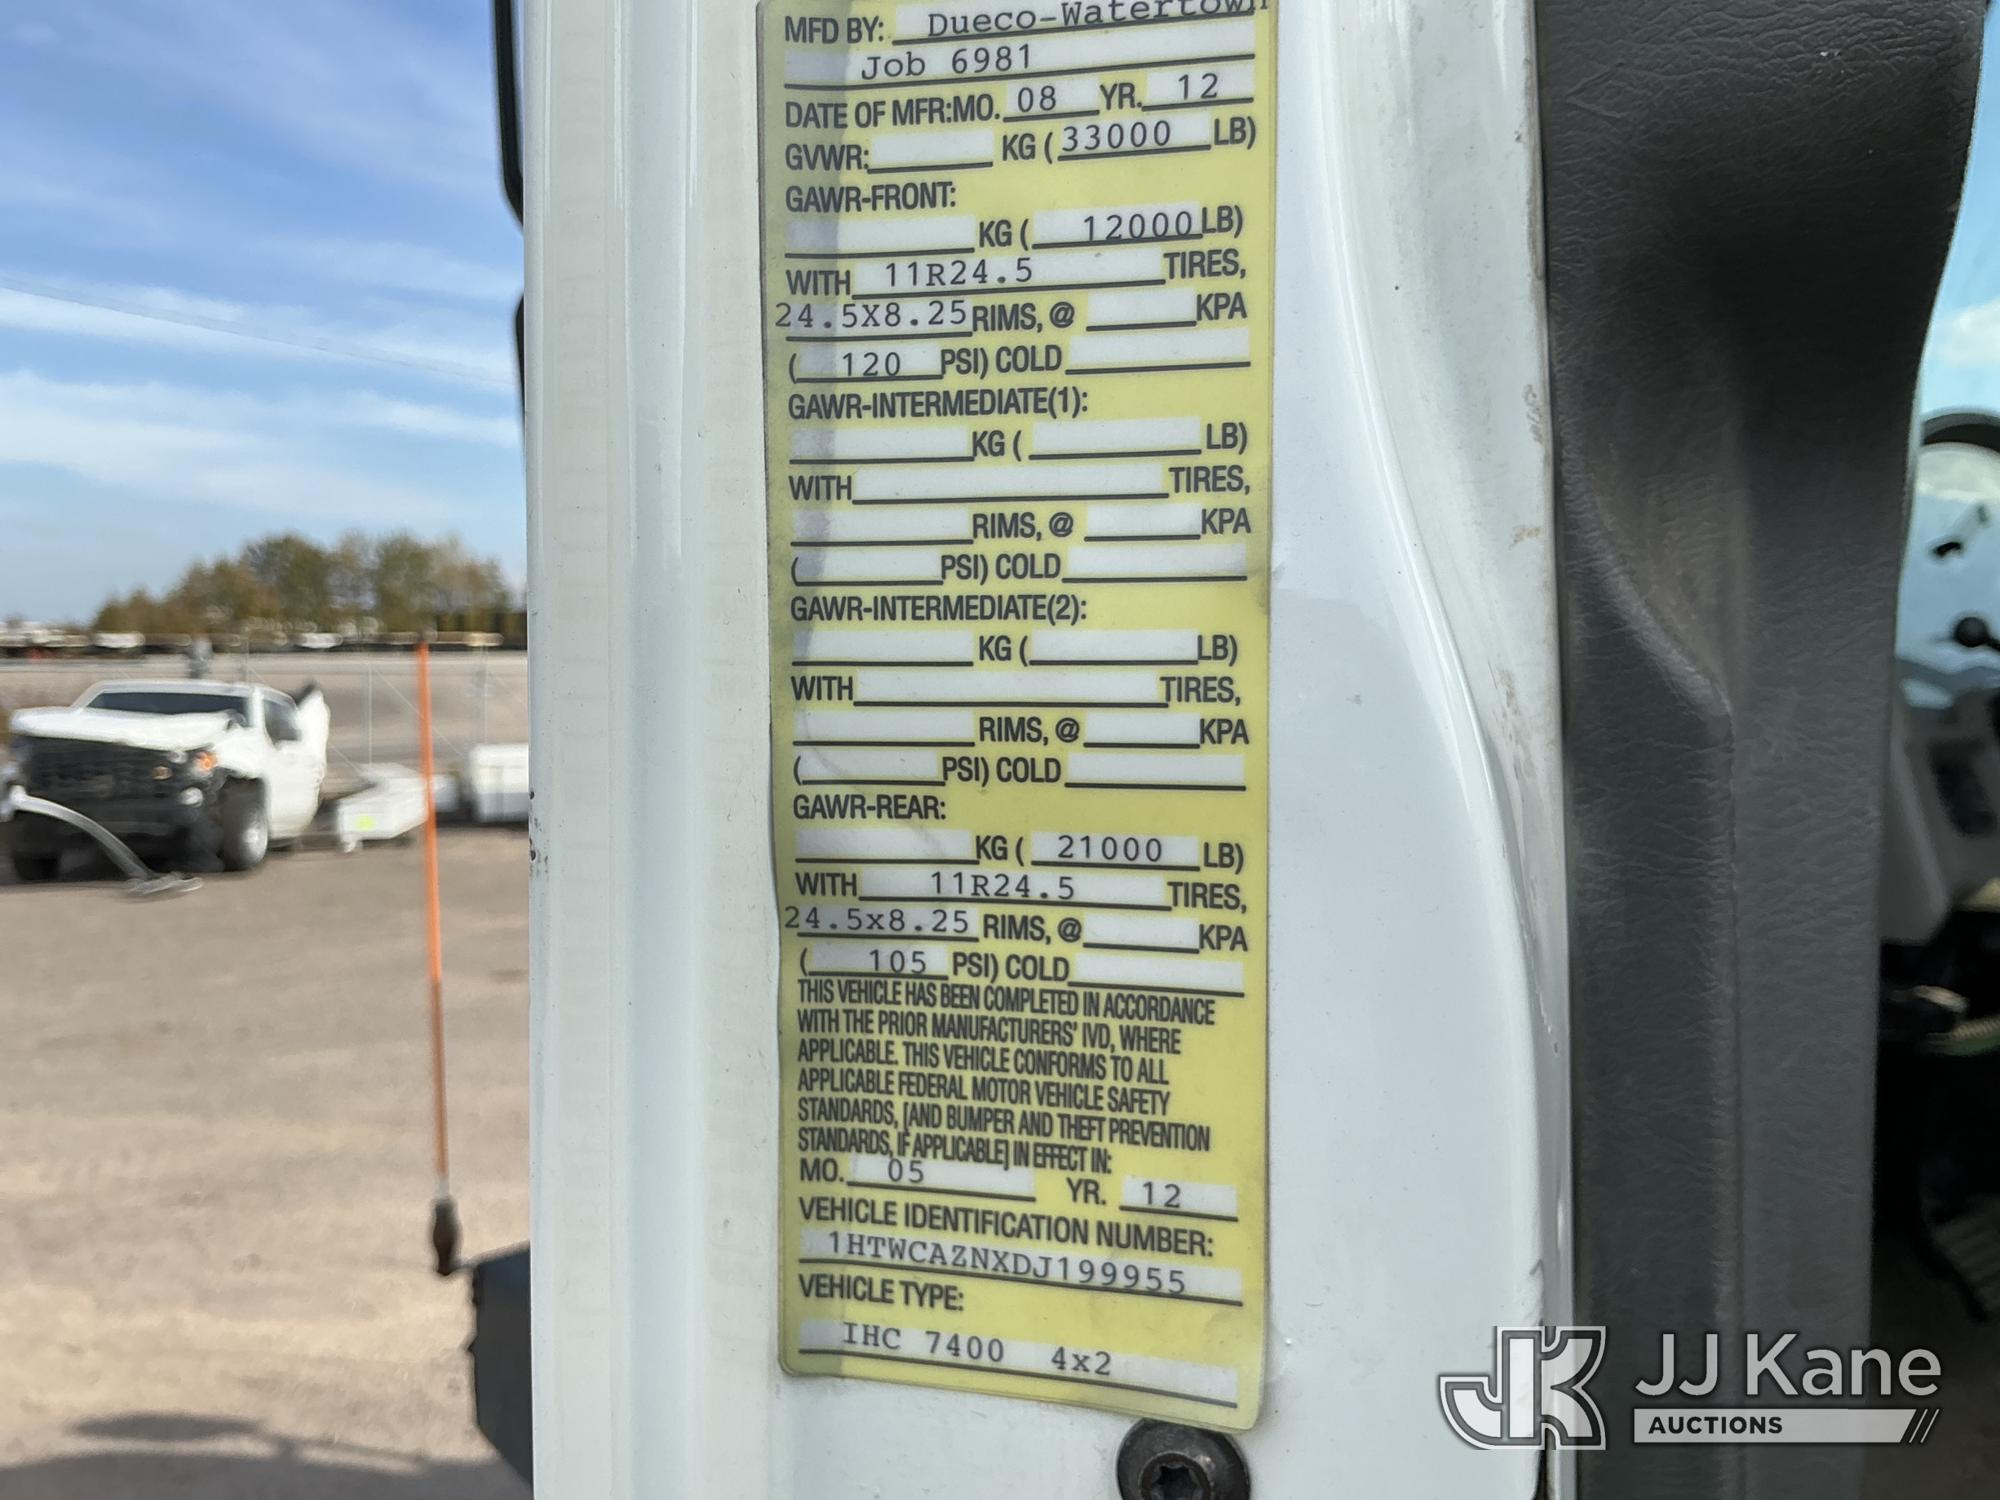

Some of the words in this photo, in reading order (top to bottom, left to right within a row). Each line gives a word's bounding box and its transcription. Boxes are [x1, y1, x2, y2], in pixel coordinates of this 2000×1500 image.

[785, 16, 839, 44] MFD
[847, 16, 884, 43] BY:
[862, 52, 925, 80] Job
[952, 43, 1032, 73] 6981
[785, 100, 848, 128] DATE
[854, 101, 885, 124] OF
[1018, 86, 1056, 113] 08
[1100, 83, 1142, 111] YR.
[1178, 73, 1218, 99] 12
[785, 143, 869, 170] GVWR:
[1002, 134, 1036, 160] KG
[1214, 118, 1256, 149] LB)
[785, 181, 956, 212] GAWR-FRONT:
[979, 222, 1012, 247] KG
[1085, 211, 1192, 239] 12000
[1202, 205, 1243, 236] LB)
[786, 270, 851, 295] WITH
[885, 257, 1033, 287] 11R24.5
[1164, 249, 1246, 280] TIRES,
[775, 300, 966, 329] 24.5X8.25
[973, 303, 1042, 333] RIMS,
[1049, 302, 1075, 328] @
[1196, 293, 1246, 321] KPA
[842, 353, 901, 377] 120
[940, 348, 988, 378] PSI)
[996, 346, 1061, 373] COLD
[788, 388, 1088, 419] GAWR-INTERMEDIATE(1):
[973, 431, 1005, 457] KG
[1206, 423, 1247, 453] LB)
[789, 476, 852, 501] WITH
[1169, 466, 1250, 497] TIRES,
[973, 513, 1042, 542] RIMS,
[1049, 512, 1074, 537] @
[1201, 508, 1251, 534] KPA
[941, 553, 988, 584] PSI)
[996, 553, 1061, 579] COLD
[791, 595, 1087, 625] GAWR-INTERMEDIATE(2):
[979, 635, 1011, 661] KG
[1198, 635, 1238, 666] LB)
[791, 677, 853, 701] WITH
[1160, 677, 1241, 706] TIRES,
[979, 717, 1049, 747] RIMS,
[1055, 718, 1080, 742] @
[1199, 719, 1249, 745] KPA
[943, 757, 990, 788] PSI)
[996, 757, 1061, 783] COLD
[793, 794, 946, 820] GAWR-REAR:
[976, 835, 1008, 860] KG
[1058, 835, 1162, 862] 21000
[1204, 843, 1244, 873] LB)
[796, 873, 857, 897] WITH
[931, 871, 1074, 900] 11R24.5
[1168, 882, 1247, 914] TIRES,
[785, 906, 969, 933] 24.5x8.25
[983, 914, 1052, 945] RIMS,
[1057, 918, 1083, 943] @
[1199, 925, 1247, 952] KPA
[870, 950, 927, 974] 105
[953, 953, 999, 984] PSI)
[1005, 955, 1070, 981] COLD
[798, 980, 835, 1002] THIS
[838, 981, 902, 1006] VEHICLE
[906, 985, 939, 1007] HAS
[942, 986, 980, 1010] BEEN
[984, 988, 1078, 1016] COMPLETED
[1083, 993, 1099, 1016] IN
[1103, 995, 1215, 1025] ACCORDANCE
[798, 1010, 839, 1032] WITH
[843, 1010, 873, 1034] THE
[878, 1012, 927, 1037] PRIOR
[1082, 1024, 1114, 1051] IVD,
[1119, 1026, 1181, 1054] WHERE
[798, 1040, 898, 1064] APPLICABLE.
[903, 1042, 939, 1067] THIS
[944, 1045, 1009, 1072] VEHICLE
[1014, 1050, 1105, 1079] CONFORMS
[1110, 1056, 1132, 1080] TO
[1136, 1059, 1169, 1084] ALL
[798, 1069, 894, 1094] APPLICABLE
[900, 1073, 967, 1100] FEDERAL
[972, 1077, 1030, 1103] MOTOR
[1035, 1082, 1103, 1110] VEHICLE
[1108, 1087, 1170, 1115] SAFETY
[798, 1098, 899, 1128] STANDARDS,
[903, 1103, 942, 1133] [AND
[946, 1106, 1014, 1132] BUMPER
[1019, 1111, 1053, 1137] AND
[1057, 1114, 1105, 1139] THEFT
[1109, 1117, 1210, 1151] PREVENTION
[798, 1127, 894, 1156] STANDARDS,
[1013, 1142, 1029, 1165] IN
[1034, 1143, 1087, 1170] EFFECT
[1091, 1148, 1112, 1174] IN:
[799, 1158, 844, 1183] MO.
[888, 1159, 924, 1182] 05
[1067, 1178, 1106, 1205] YR.
[1143, 1182, 1180, 1208] 12
[799, 1198, 897, 1225] VEHICLE
[904, 1203, 1088, 1244] IDENTIFICATION
[1096, 1221, 1213, 1257] NUMBER:
[799, 1274, 894, 1303] VEHICLE
[900, 1280, 963, 1311] TYPE:
[842, 1322, 900, 1349] IHC
[925, 1330, 1004, 1362] 7400
[1051, 1347, 1111, 1375] 4x2
